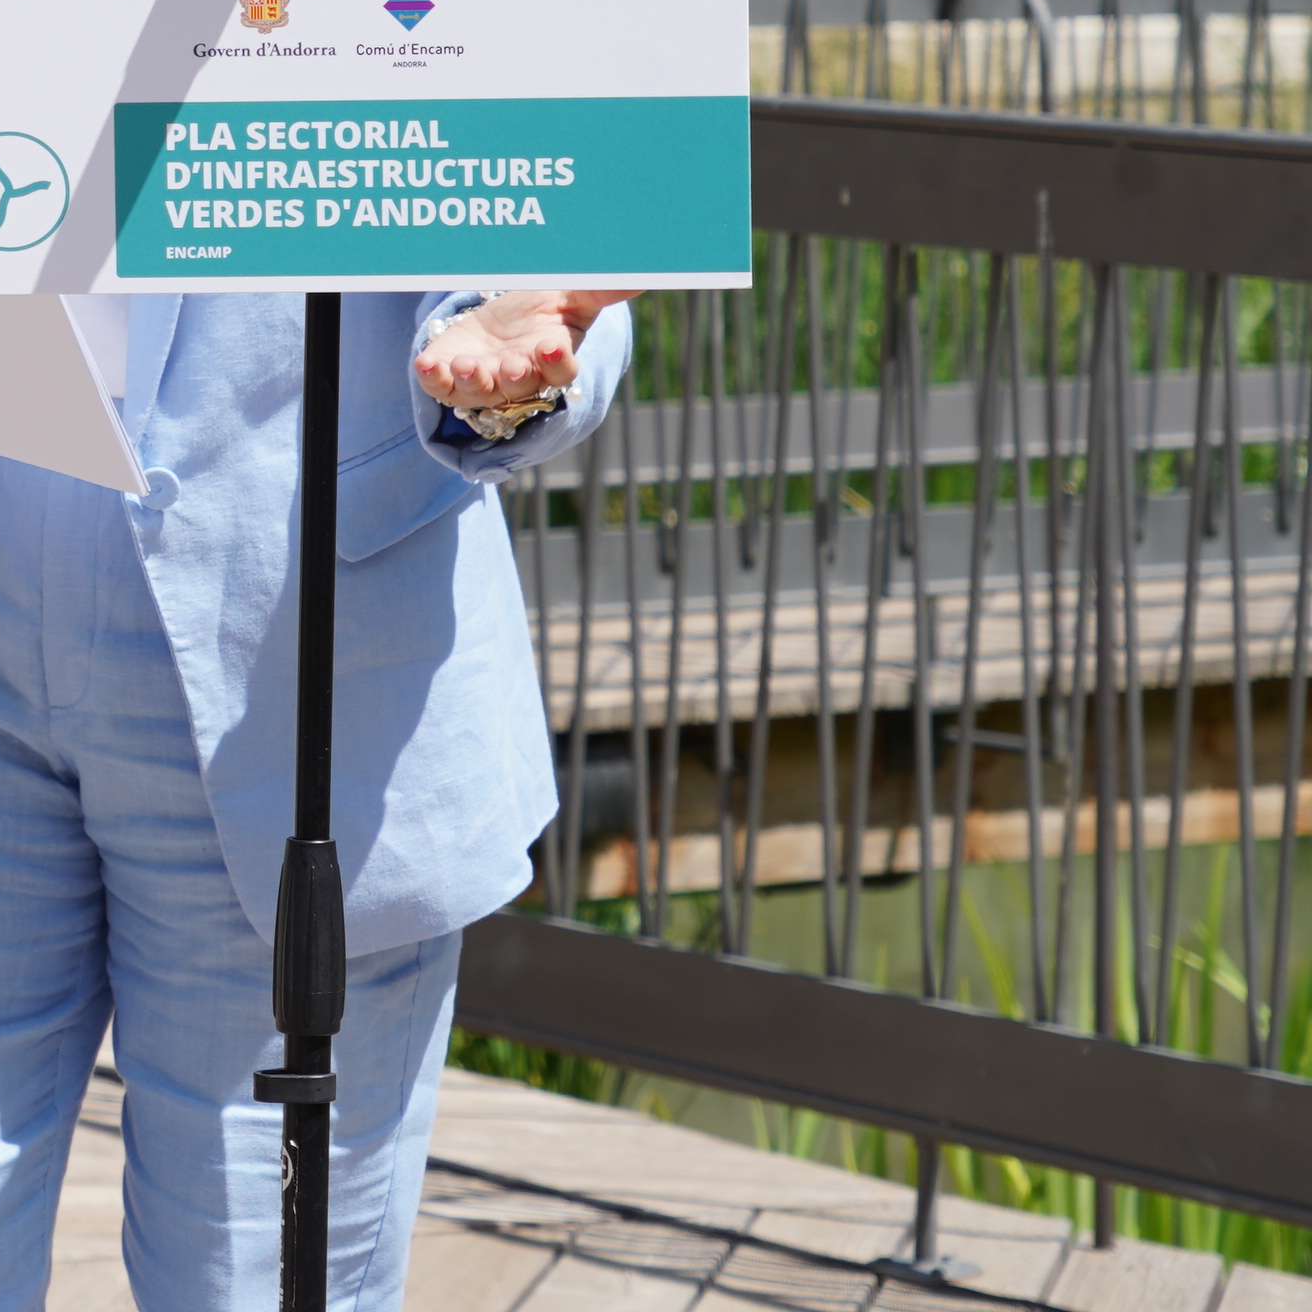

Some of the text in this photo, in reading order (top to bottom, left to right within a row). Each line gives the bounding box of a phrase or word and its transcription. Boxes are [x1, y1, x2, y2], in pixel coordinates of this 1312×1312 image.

[192, 42, 337, 58] Govern d’Andorra
[356, 43, 465, 57] Comú d'Encamp
[165, 120, 449, 151] PLA SECTORIAL
[165, 157, 576, 190] D’INFRAESTRUCTURES
[165, 197, 547, 229] VERDES D'ANDORRA
[165, 246, 233, 260] ENCAMP
